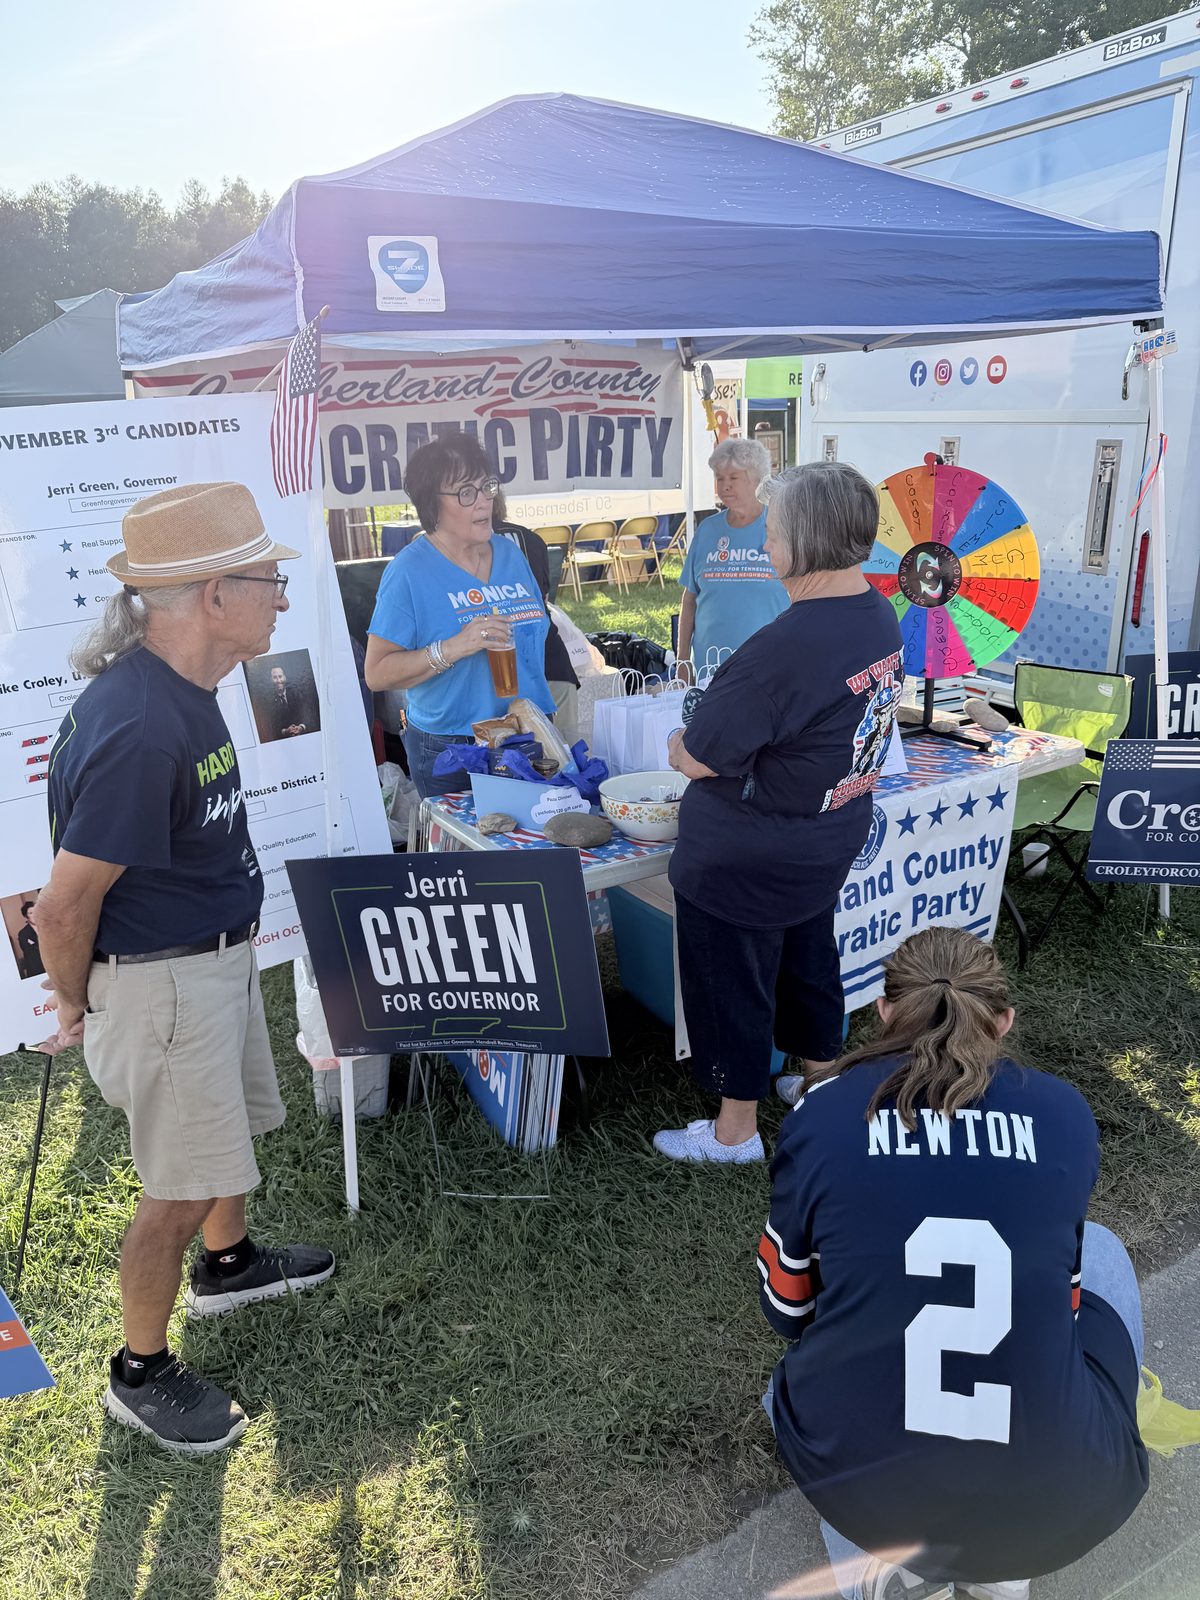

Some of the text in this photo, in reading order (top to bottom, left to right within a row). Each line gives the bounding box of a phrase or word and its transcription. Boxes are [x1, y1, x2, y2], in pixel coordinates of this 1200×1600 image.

[1105, 31, 1162, 60] BizBox
[846, 125, 879, 144] BizBox
[511, 356, 662, 401] County
[94, 425, 119, 443] 3rd
[125, 418, 241, 440] CANDIDATES
[47, 474, 178, 498] Jerri Green, Governor
[81, 538, 124, 549] Real Suppo
[23, 676, 68, 691] Croley,
[846, 669, 871, 695] WE
[245, 785, 278, 799] House
[281, 775, 318, 790] District
[262, 840, 285, 852] Quality
[285, 831, 317, 845] Education
[1145, 831, 1174, 842] FOR
[903, 834, 1004, 887] County
[1095, 864, 1200, 878] CROLEYFORCO
[404, 869, 469, 899] Jerri
[911, 881, 986, 928] Party
[359, 903, 538, 987] GREEN
[381, 991, 541, 1013] FOR GOVERNOR
[867, 1108, 1038, 1163] NEWTON
[904, 1216, 1012, 1445] 2
